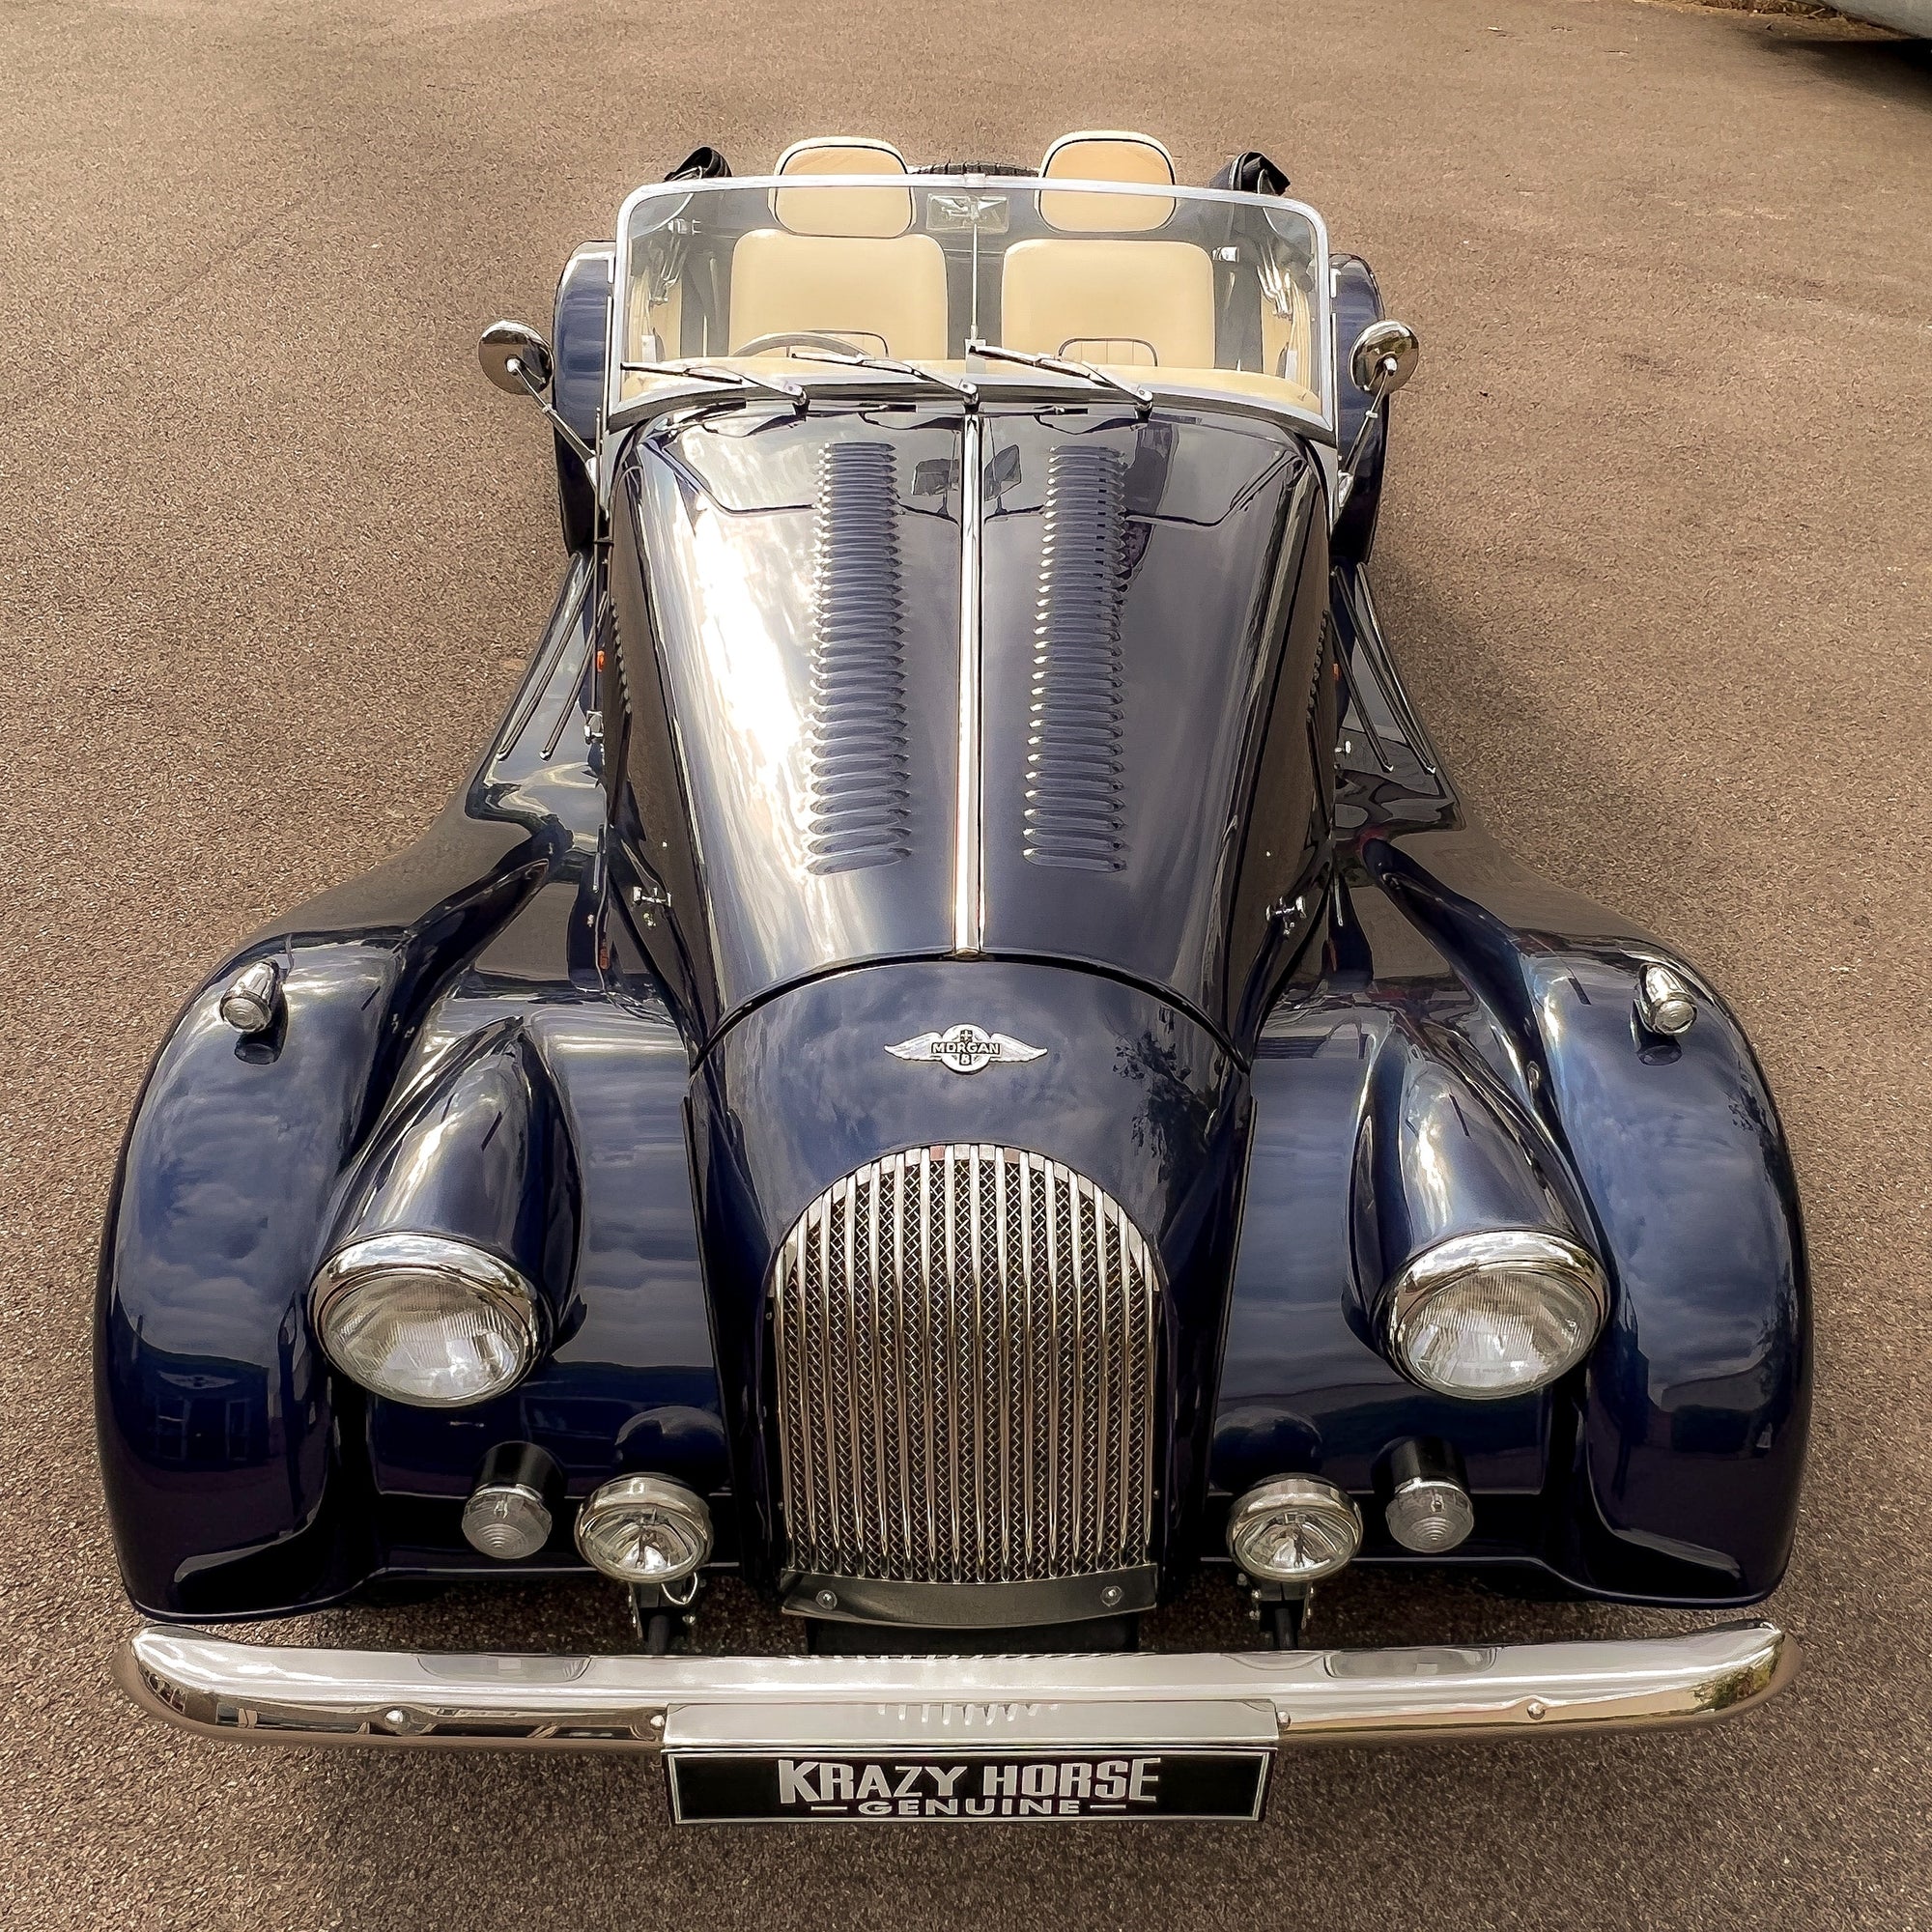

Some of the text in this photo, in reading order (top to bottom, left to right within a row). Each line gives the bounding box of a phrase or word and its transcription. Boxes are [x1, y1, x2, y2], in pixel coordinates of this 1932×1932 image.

[932, 1042, 999, 1054] MORGAN
[778, 1757, 1161, 1804] KRAZY HORSE
[858, 1798, 1080, 1816] GENUINE
